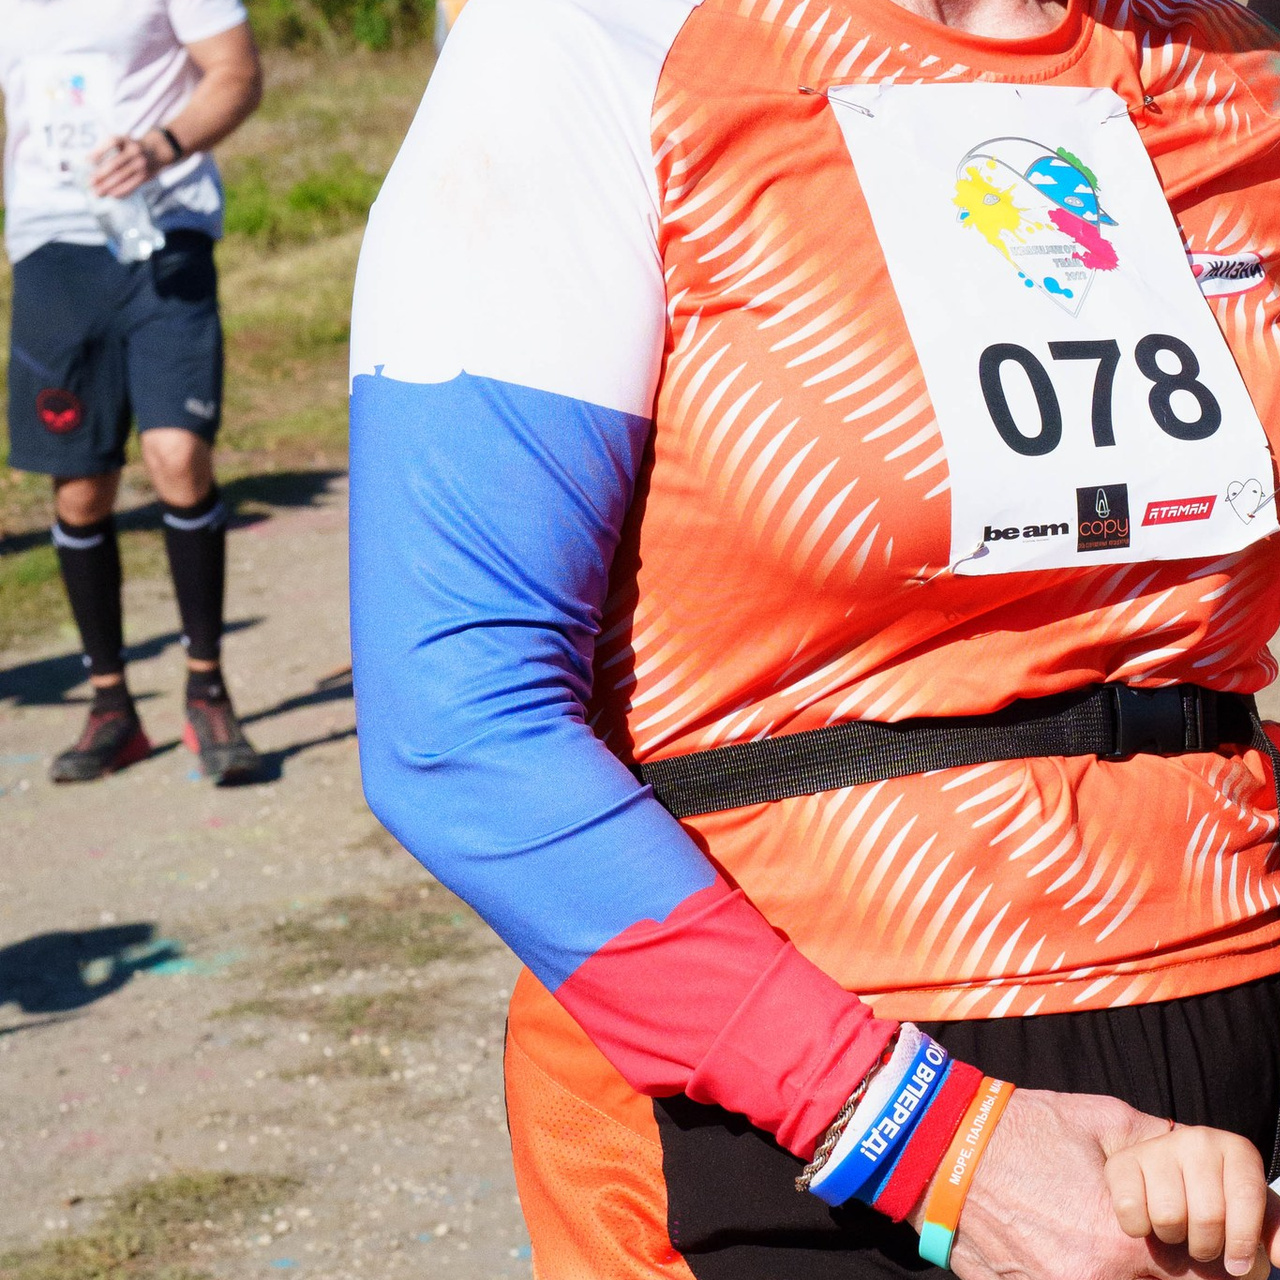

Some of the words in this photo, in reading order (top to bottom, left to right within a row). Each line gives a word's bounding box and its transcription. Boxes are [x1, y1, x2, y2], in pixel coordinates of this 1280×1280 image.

[44, 122, 99, 149] 125
[978, 333, 1222, 457] 078
[1080, 518, 1129, 539] copy
[860, 1062, 936, 1162] ВПЕРЕД!
[948, 1148, 976, 1186] МОРЕ,
[965, 1094, 998, 1145] ПАЛЬМЫ,
